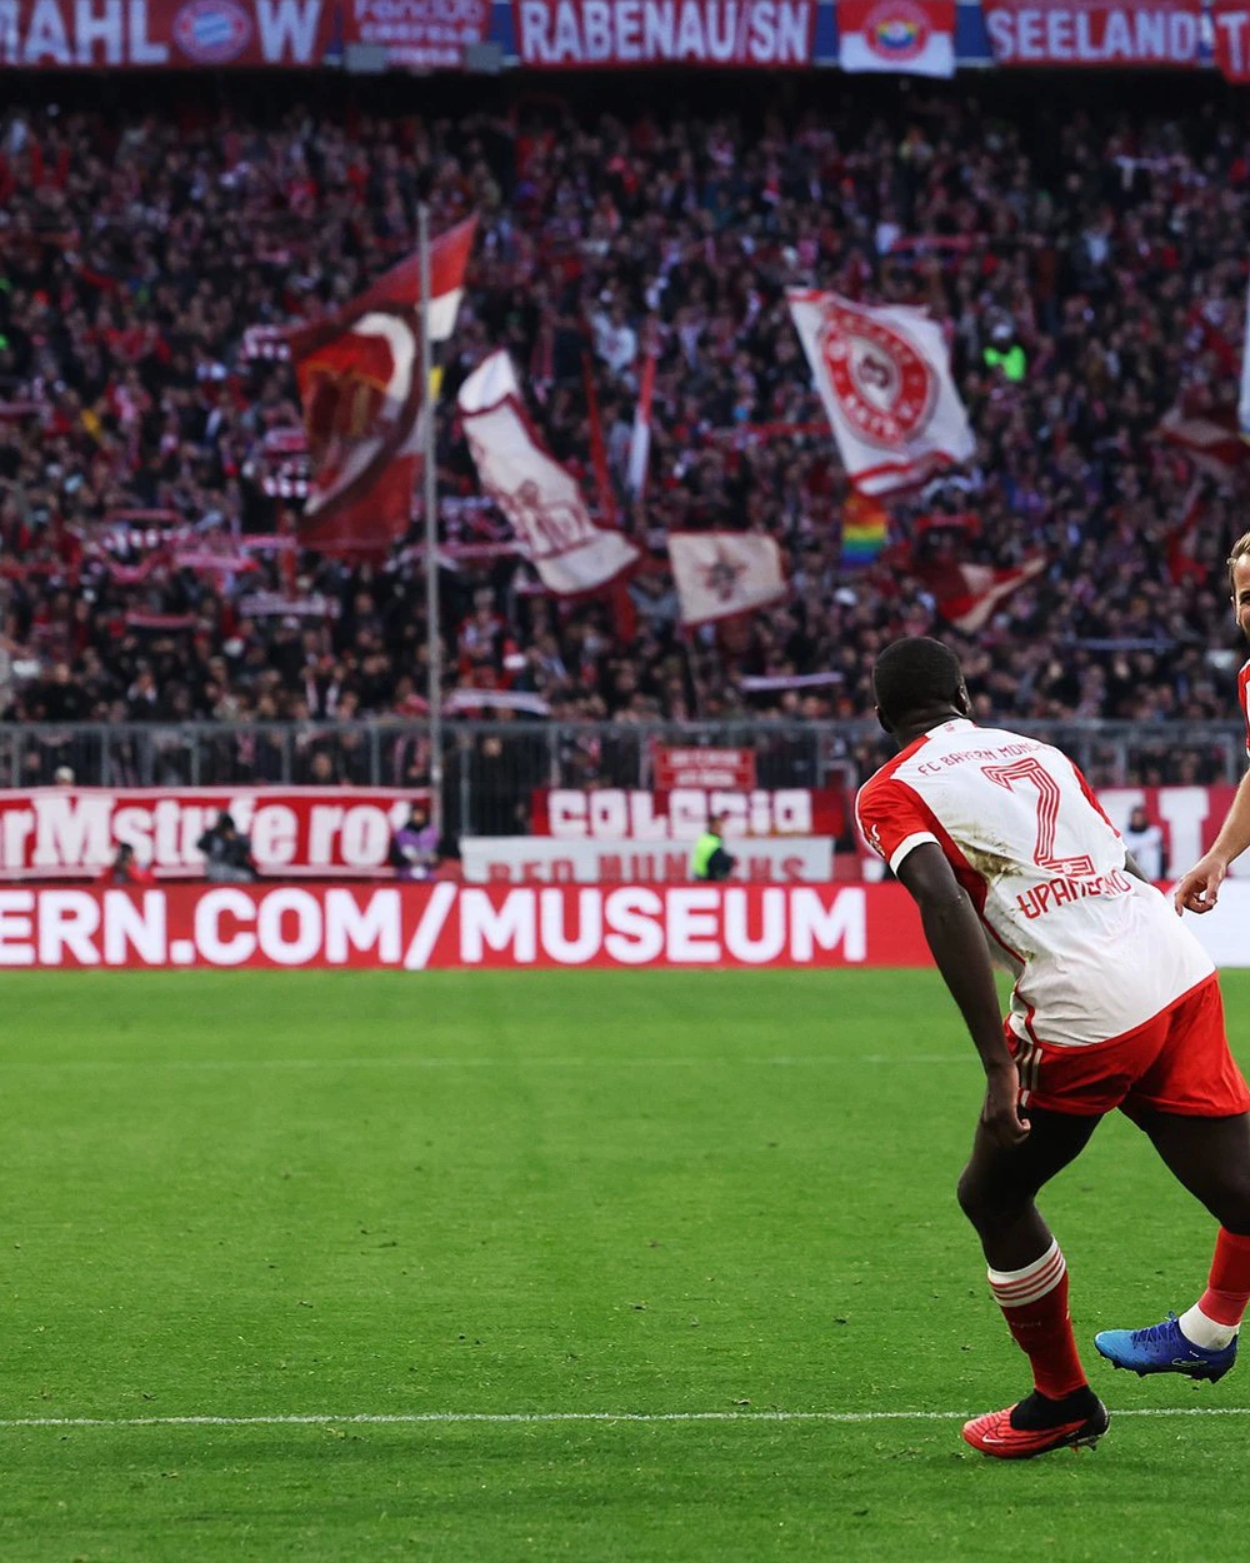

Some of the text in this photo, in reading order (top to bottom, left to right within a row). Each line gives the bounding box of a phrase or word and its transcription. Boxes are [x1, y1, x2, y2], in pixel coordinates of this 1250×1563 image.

[520, 1, 802, 63] RABENAU/SN
[988, 10, 1196, 61] SEELAND
[917, 763, 941, 776] FC
[940, 749, 998, 767] BAYERN
[980, 757, 1096, 878] 2
